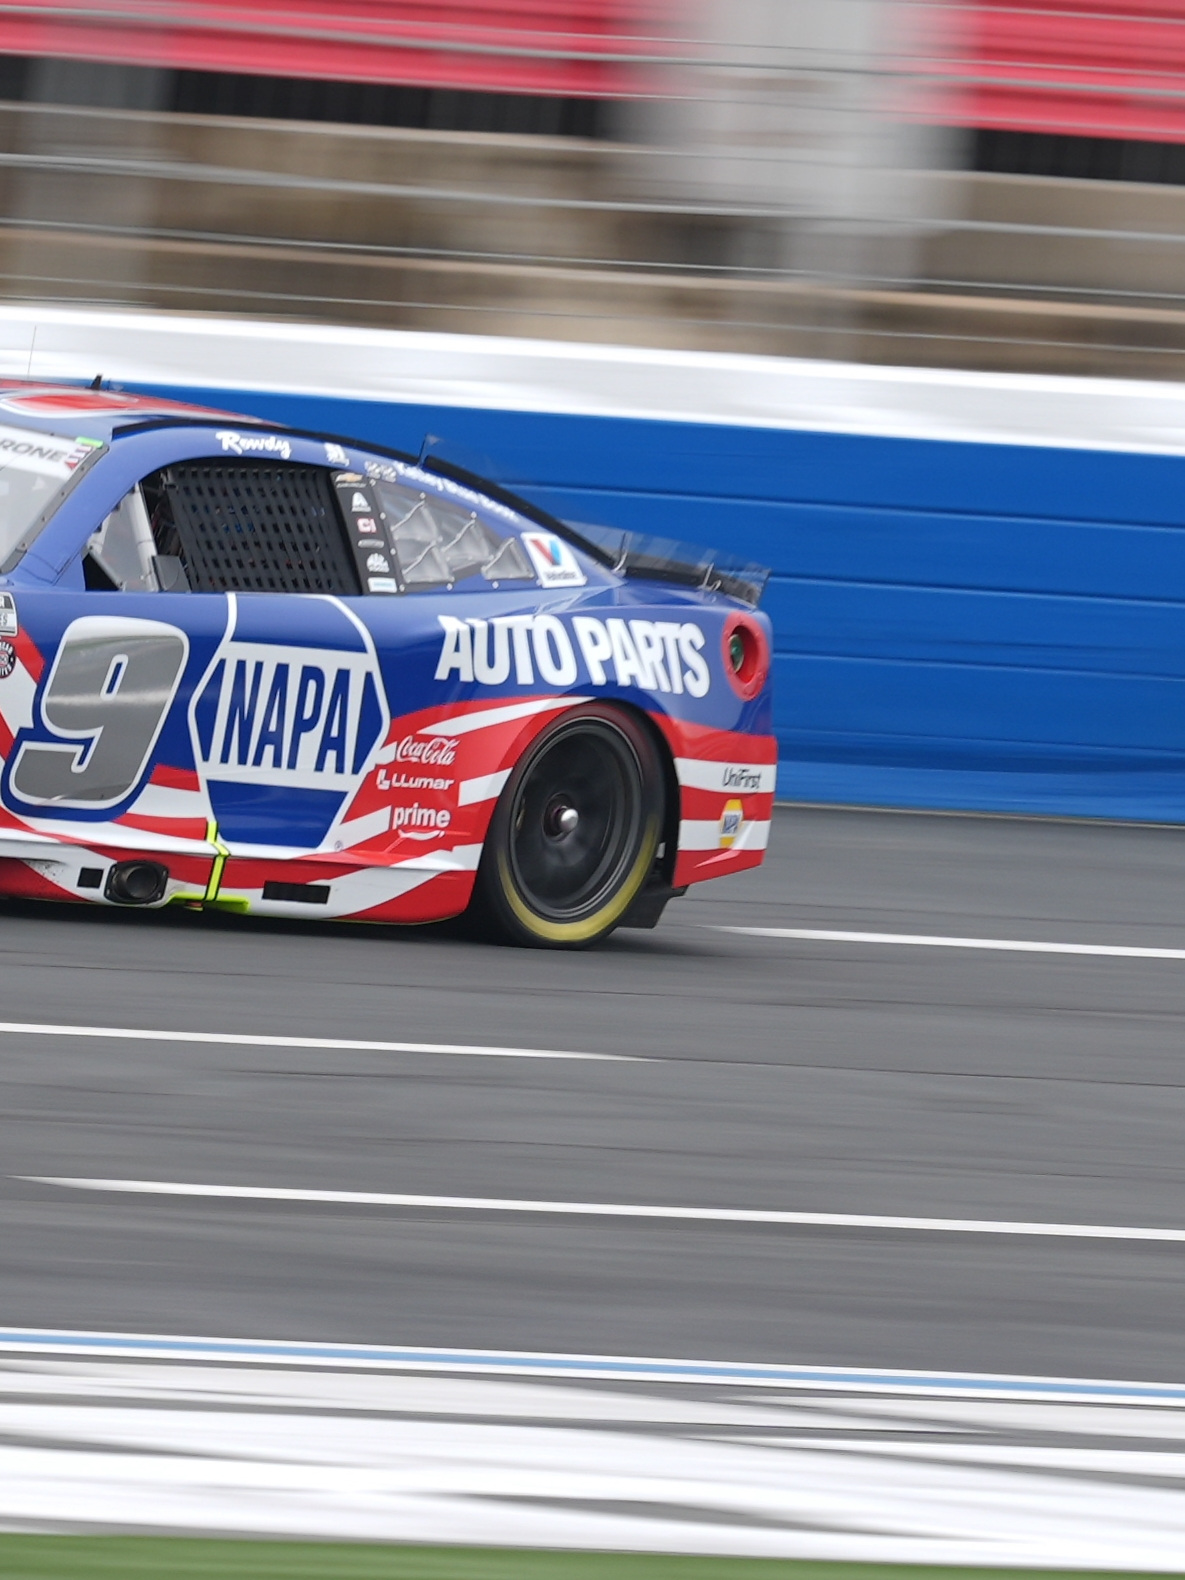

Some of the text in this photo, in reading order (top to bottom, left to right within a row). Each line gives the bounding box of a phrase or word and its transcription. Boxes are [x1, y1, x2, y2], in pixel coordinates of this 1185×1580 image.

[434, 614, 710, 698] AUTO PARTS
[9, 615, 189, 809] 9
[220, 658, 351, 775] NAPA
[392, 802, 451, 829] prime
[722, 767, 762, 789] UniFirst
